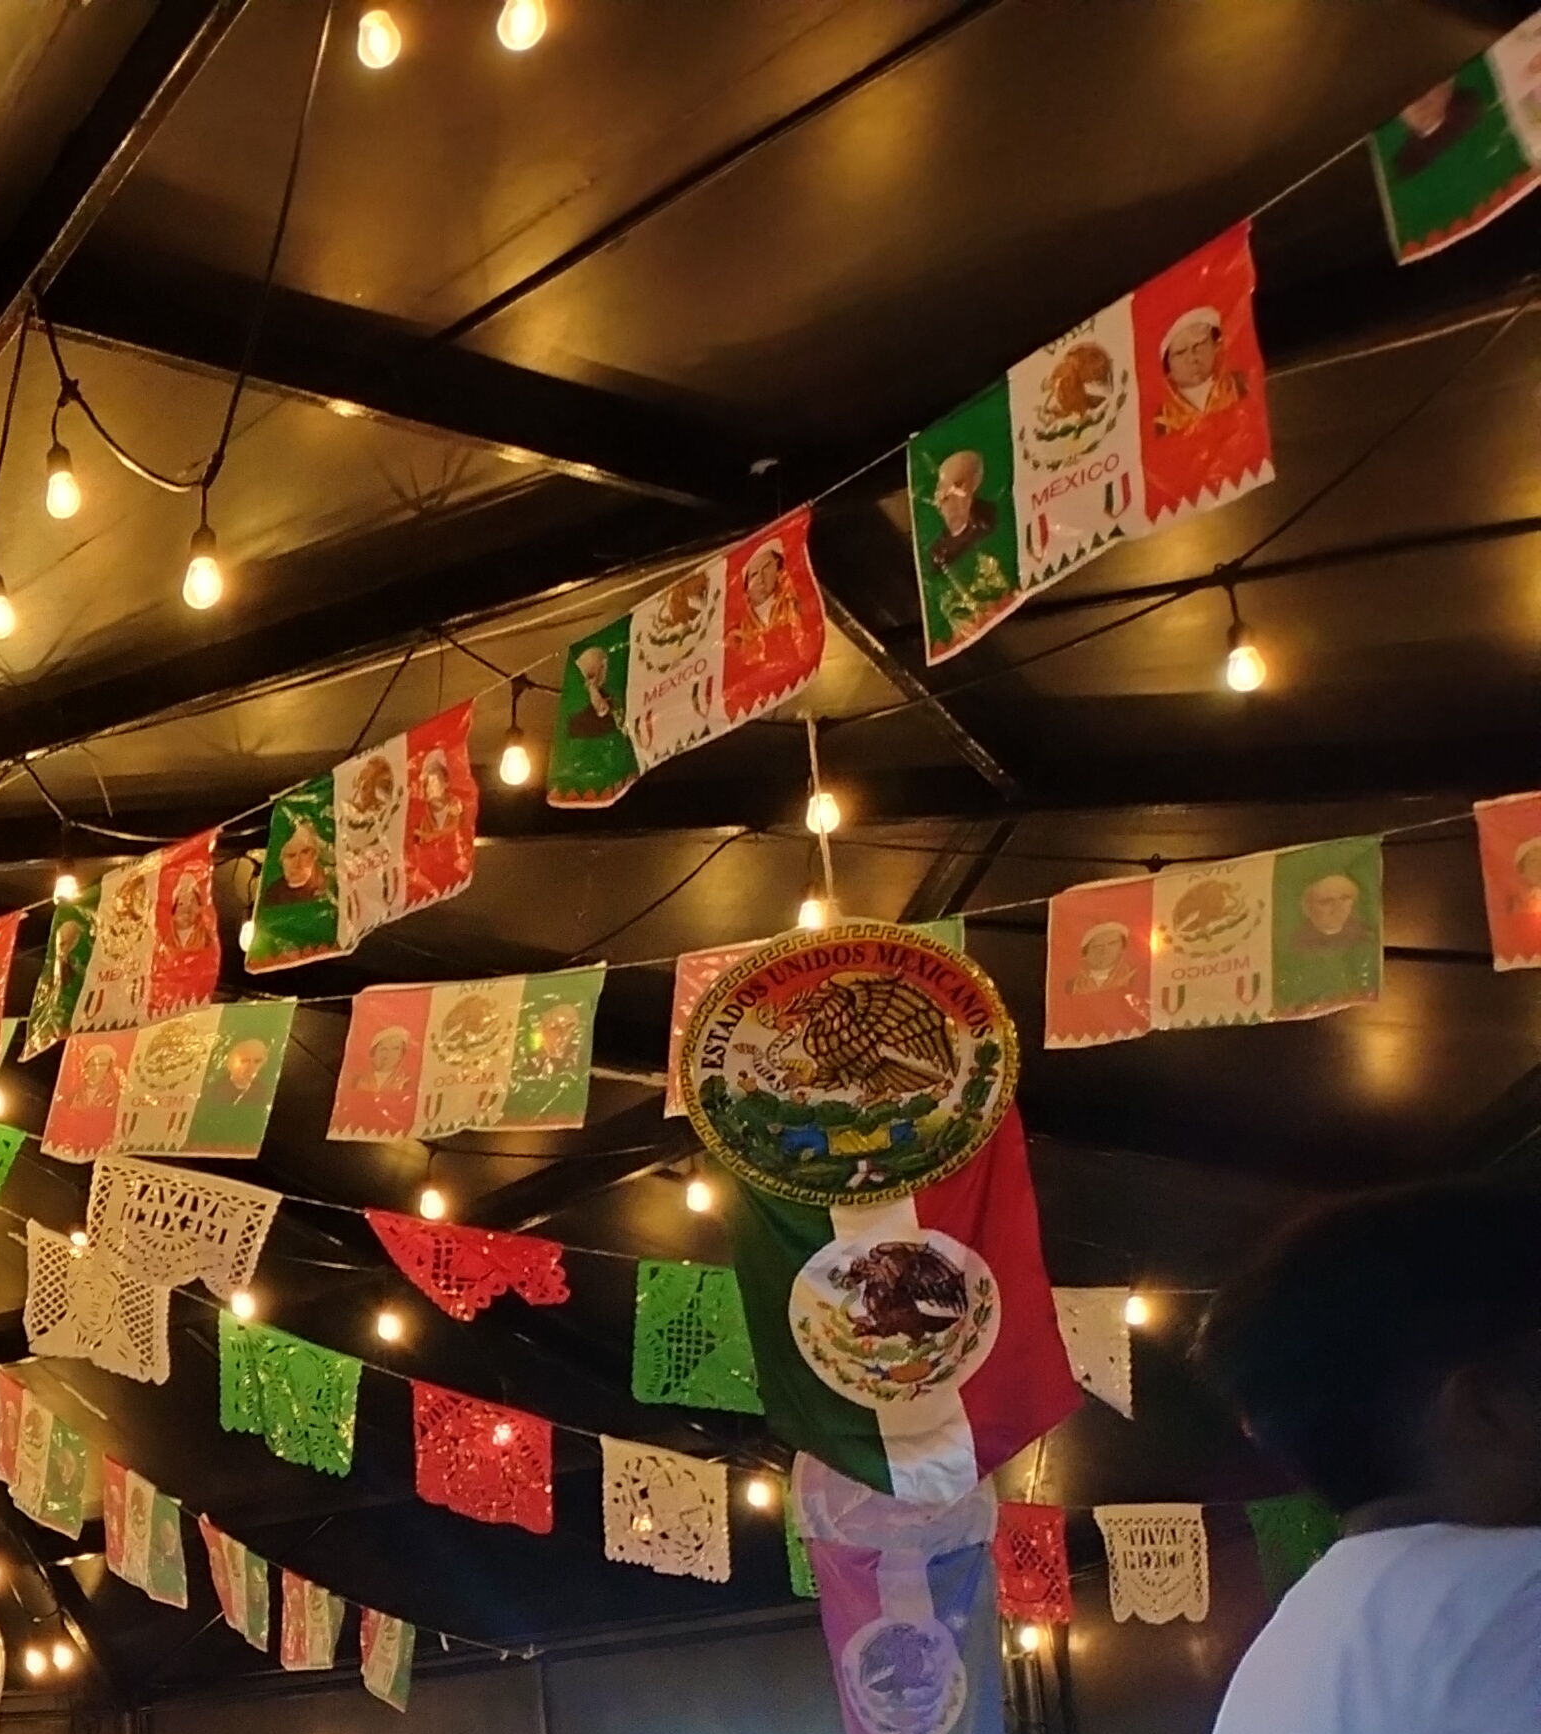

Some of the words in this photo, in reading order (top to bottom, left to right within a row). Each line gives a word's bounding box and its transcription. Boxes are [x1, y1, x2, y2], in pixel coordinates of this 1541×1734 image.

[1031, 453, 1121, 509] MEXICO
[643, 658, 708, 705] MEXICO
[701, 981, 768, 1070] ESTADOS
[767, 943, 865, 986] UNIDOS
[872, 943, 994, 1039] MEXICANOS
